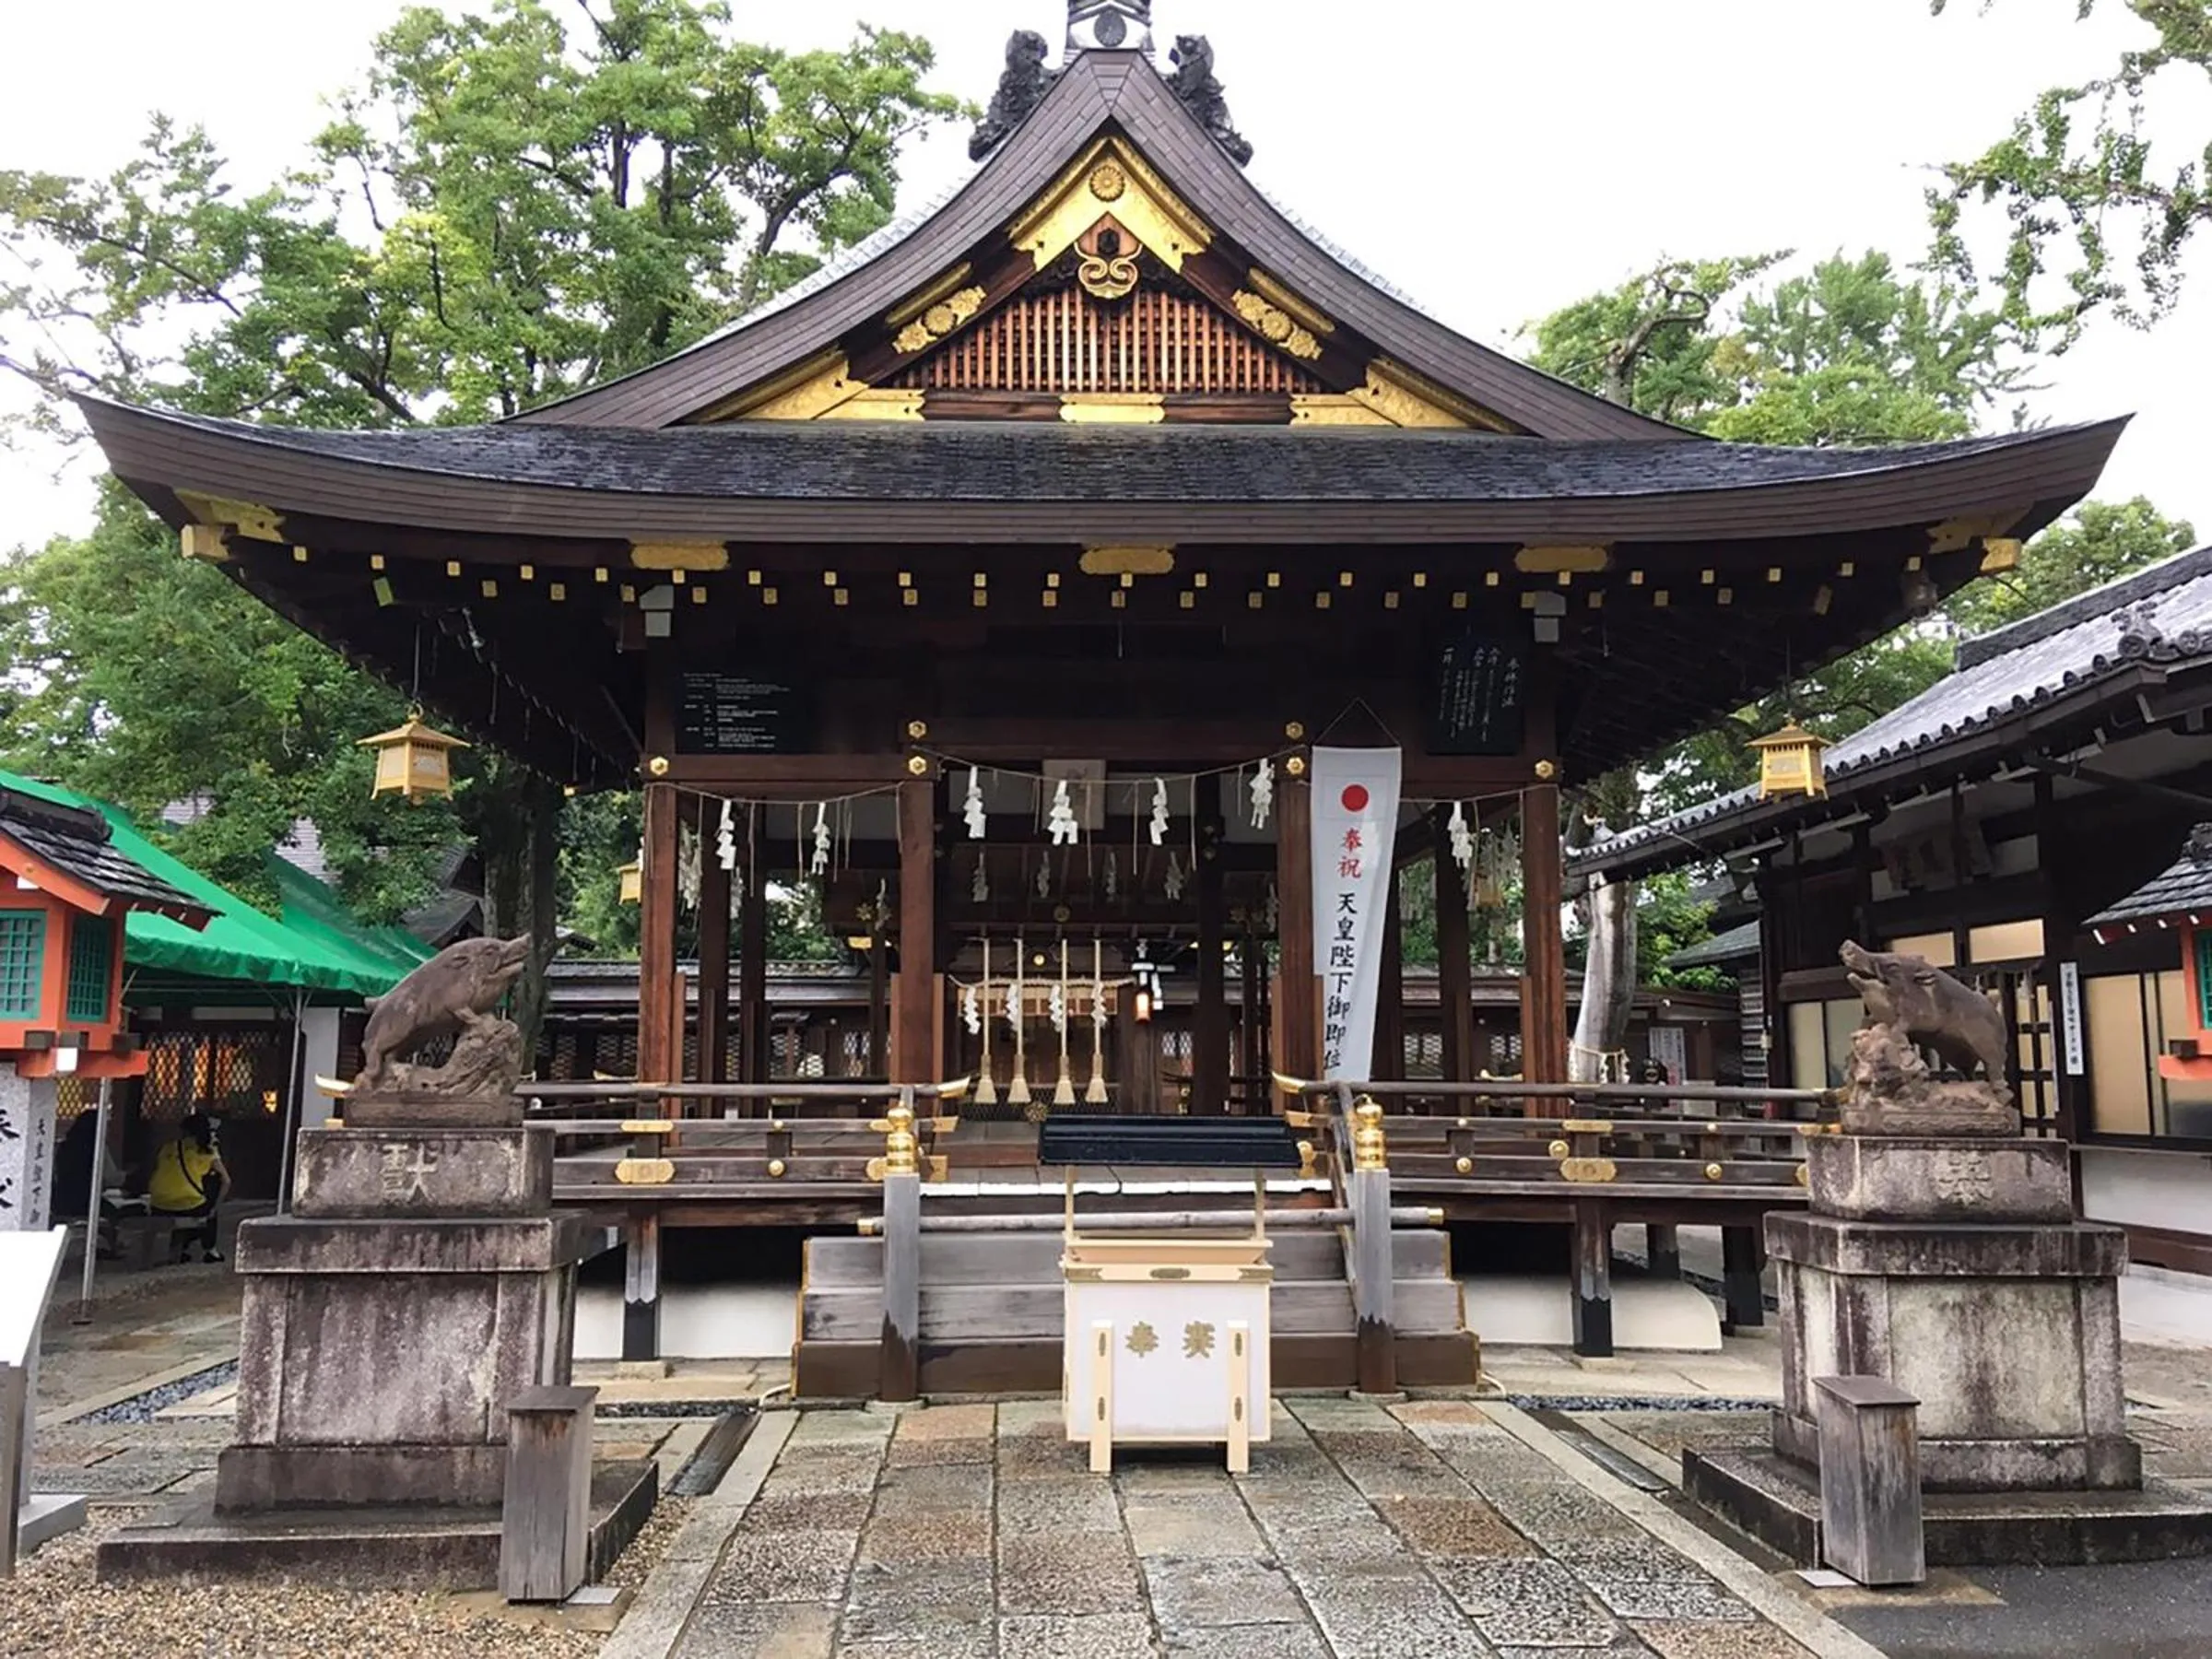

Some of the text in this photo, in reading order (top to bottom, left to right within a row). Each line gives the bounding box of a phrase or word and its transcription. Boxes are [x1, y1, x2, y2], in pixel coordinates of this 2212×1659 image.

[1324, 828, 1363, 1071] 奉祝 天皇陛下御即位
